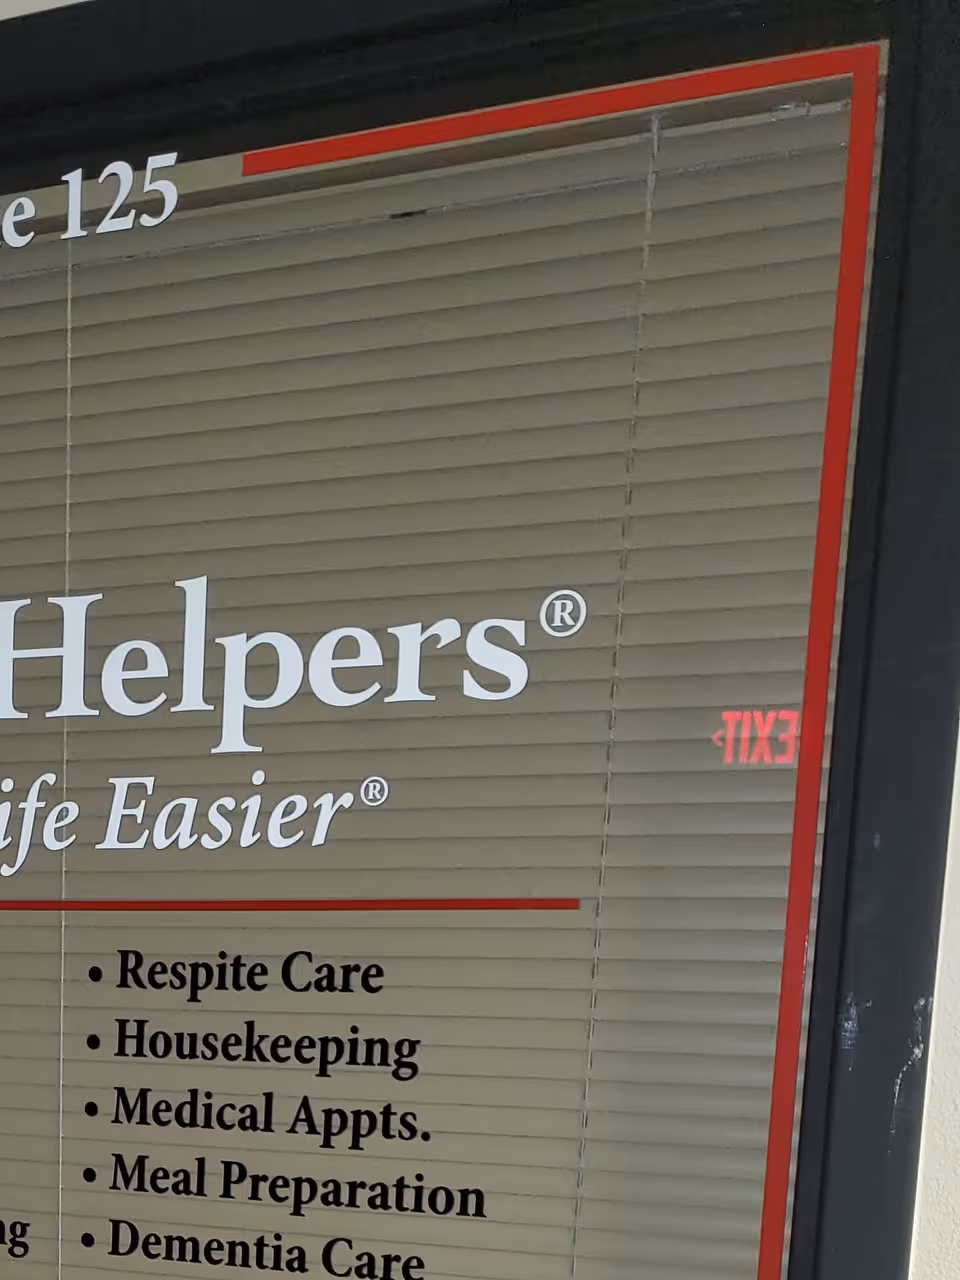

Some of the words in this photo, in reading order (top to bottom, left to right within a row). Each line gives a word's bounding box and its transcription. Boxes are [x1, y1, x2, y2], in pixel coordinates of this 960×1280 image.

[60, 152, 178, 239] 125
[116, 949, 269, 1003] Respite
[281, 951, 385, 994] Care
[113, 1018, 421, 1082] Housekeeping
[110, 1086, 275, 1133] Medical
[285, 1095, 432, 1151] Appts.
[108, 1152, 208, 1198] Meal
[219, 1160, 487, 1218] Preparation
[107, 1219, 310, 1274] Dementia
